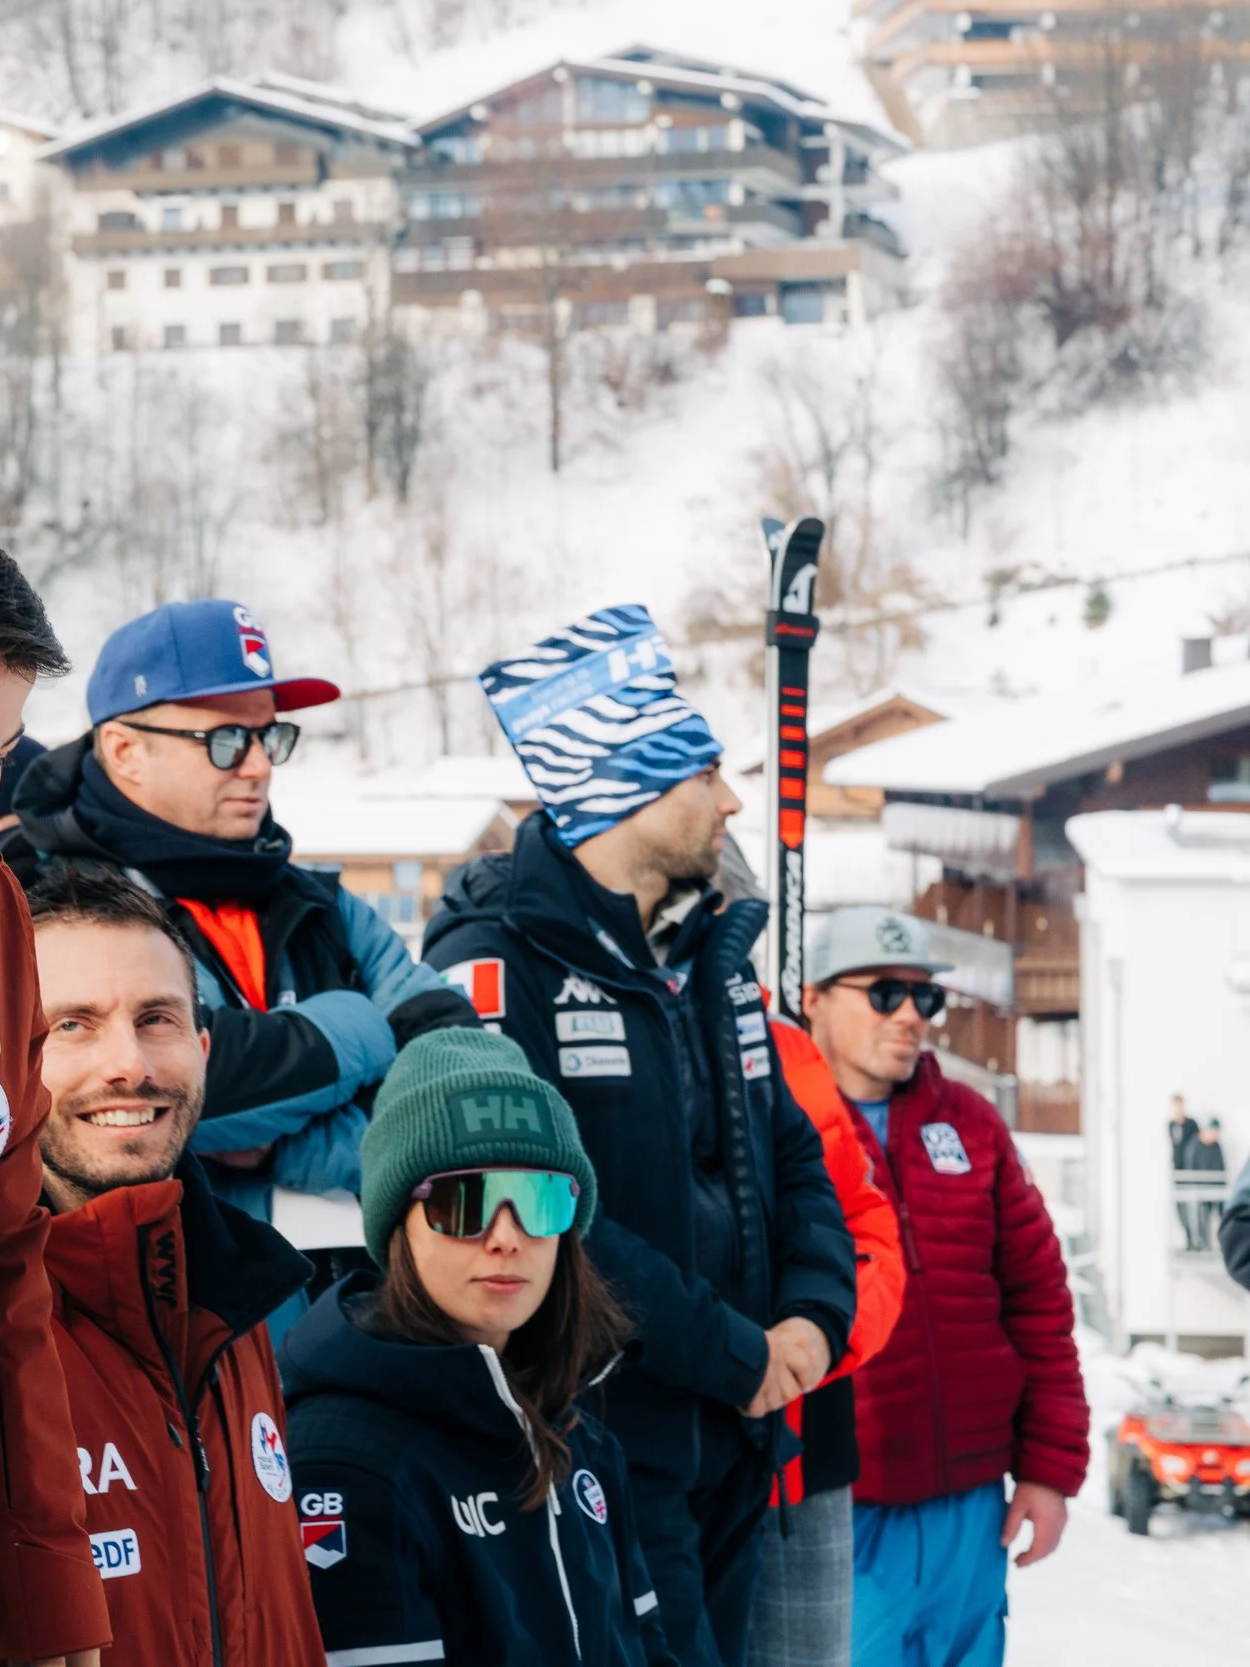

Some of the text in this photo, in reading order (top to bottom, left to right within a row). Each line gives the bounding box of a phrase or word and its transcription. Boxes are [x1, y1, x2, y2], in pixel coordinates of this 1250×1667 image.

[460, 1095, 542, 1134] HH
[76, 1442, 138, 1495] RA
[300, 1493, 344, 1516] GB
